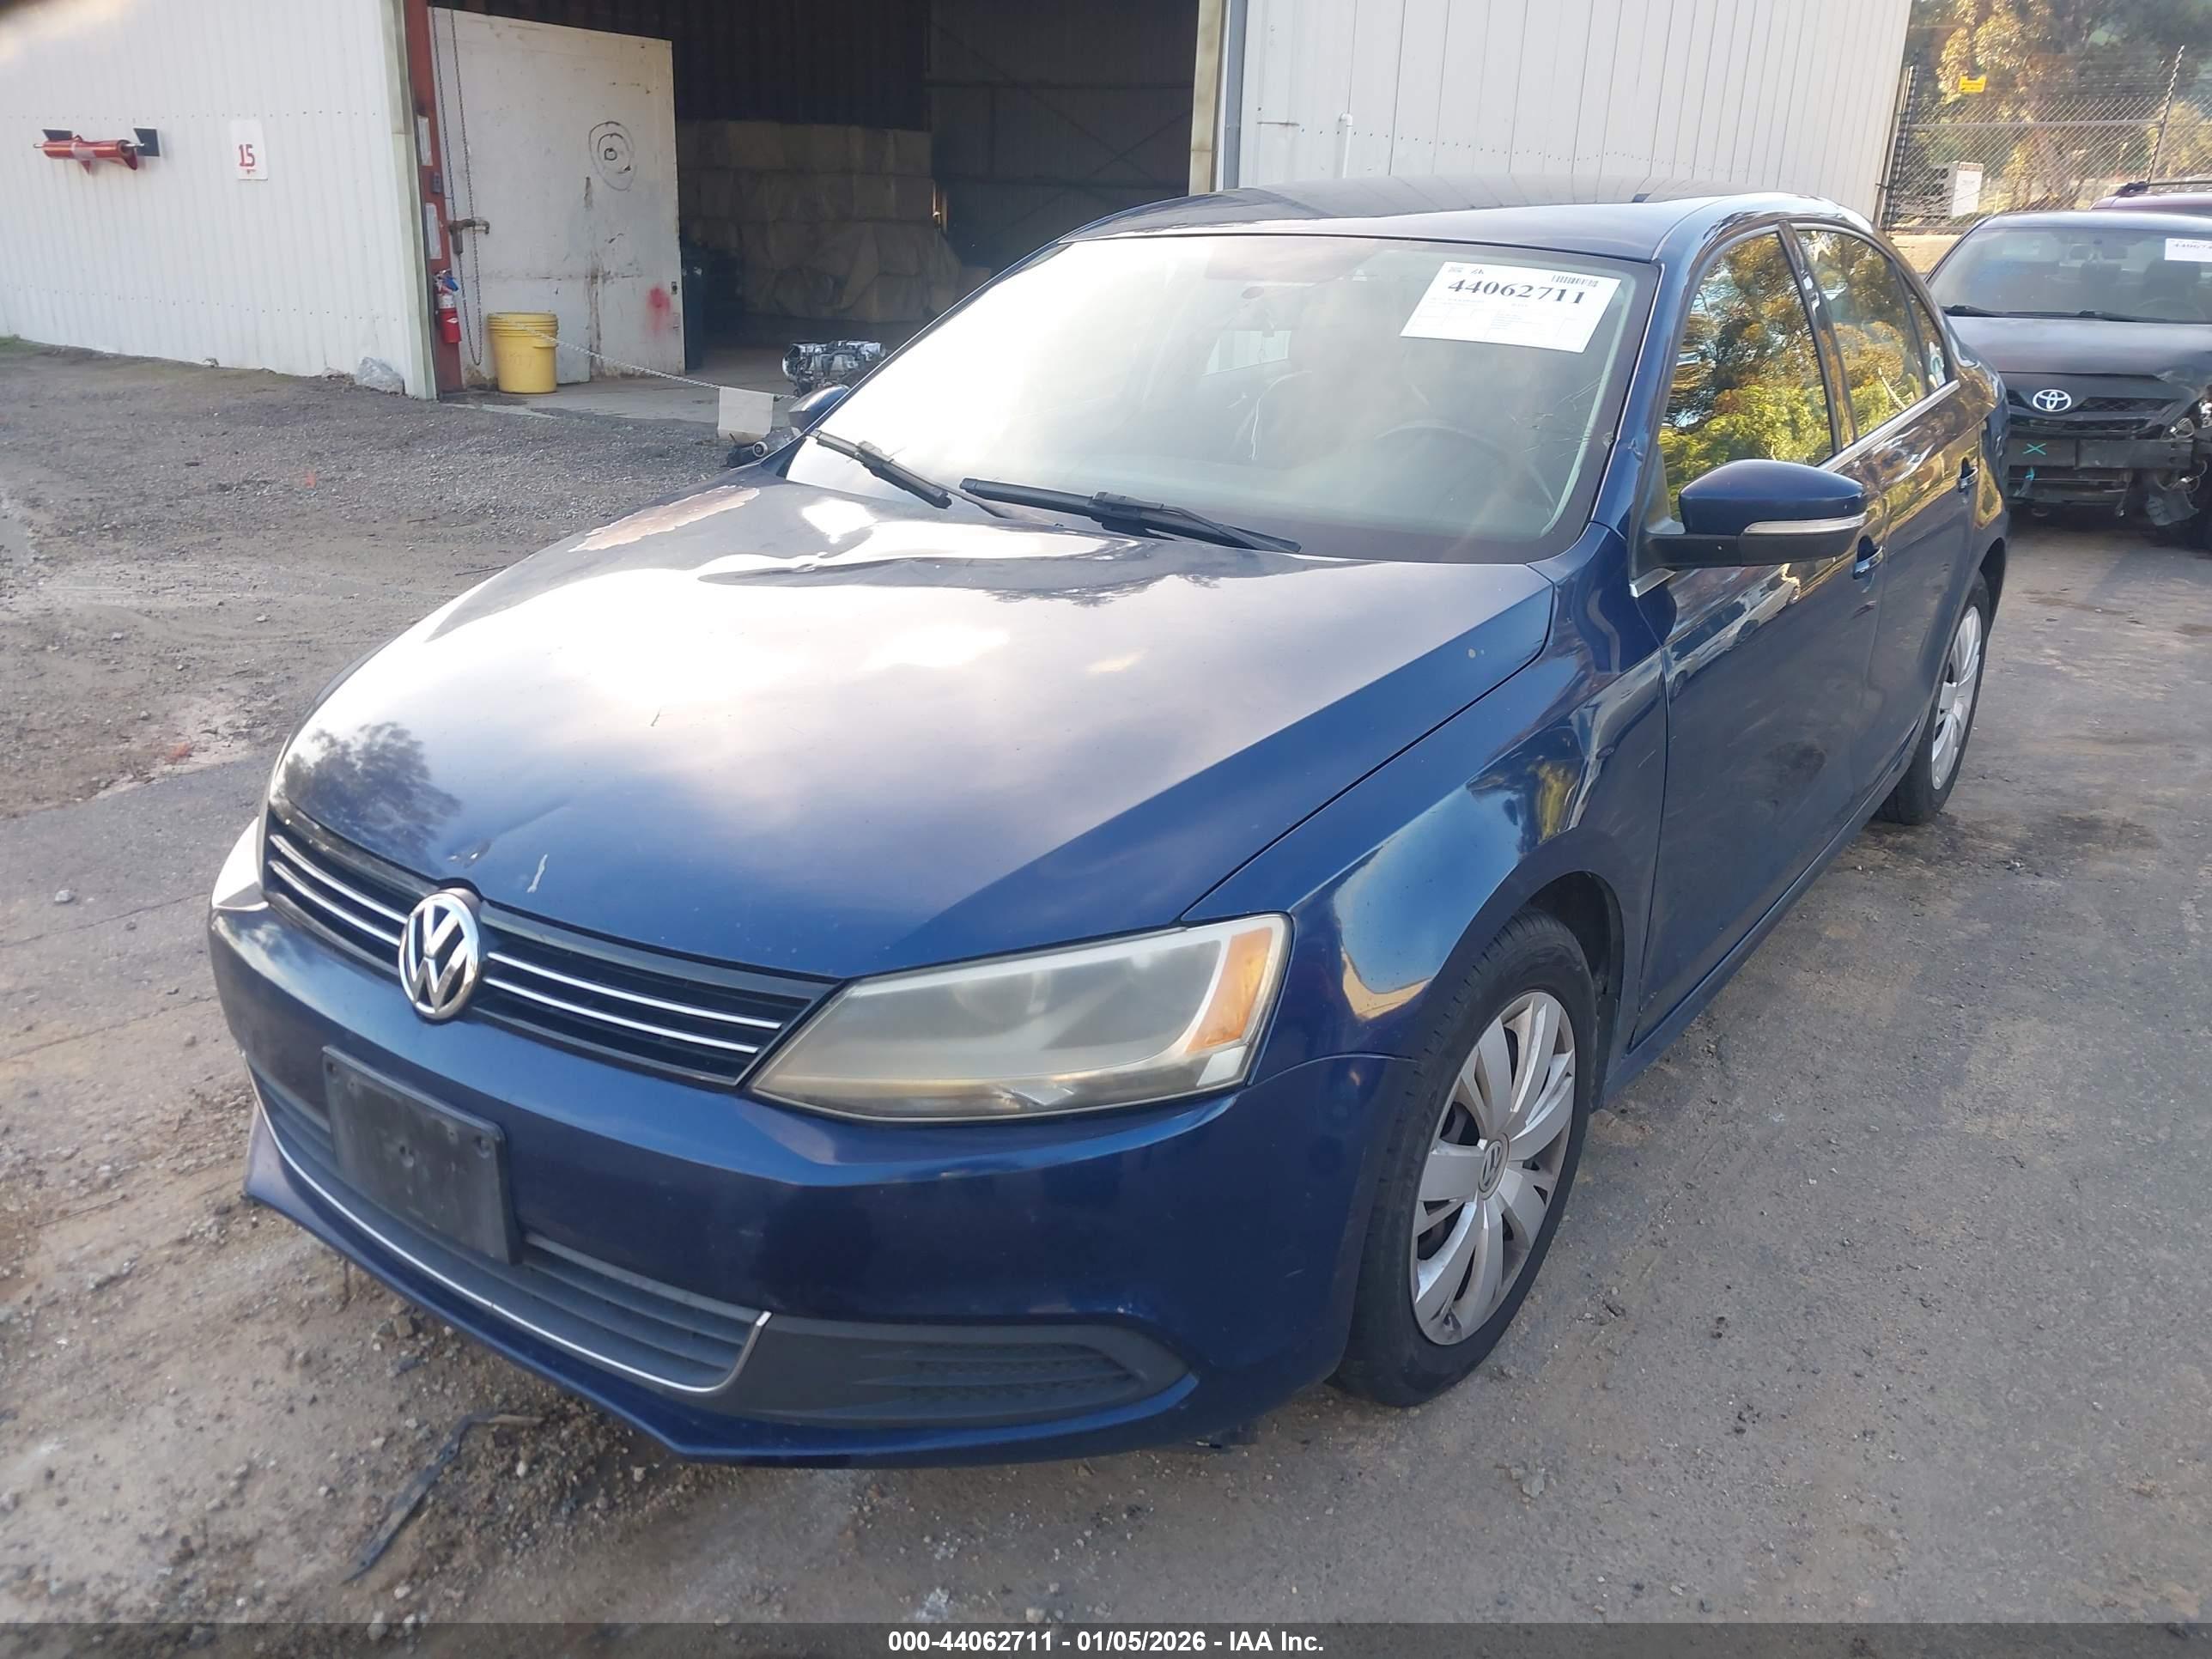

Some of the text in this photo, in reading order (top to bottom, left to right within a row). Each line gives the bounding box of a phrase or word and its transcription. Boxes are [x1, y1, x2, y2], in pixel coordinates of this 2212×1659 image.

[239, 143, 255, 167] 15
[1447, 278, 1586, 305] 44062711
[403, 897, 475, 1017] VW
